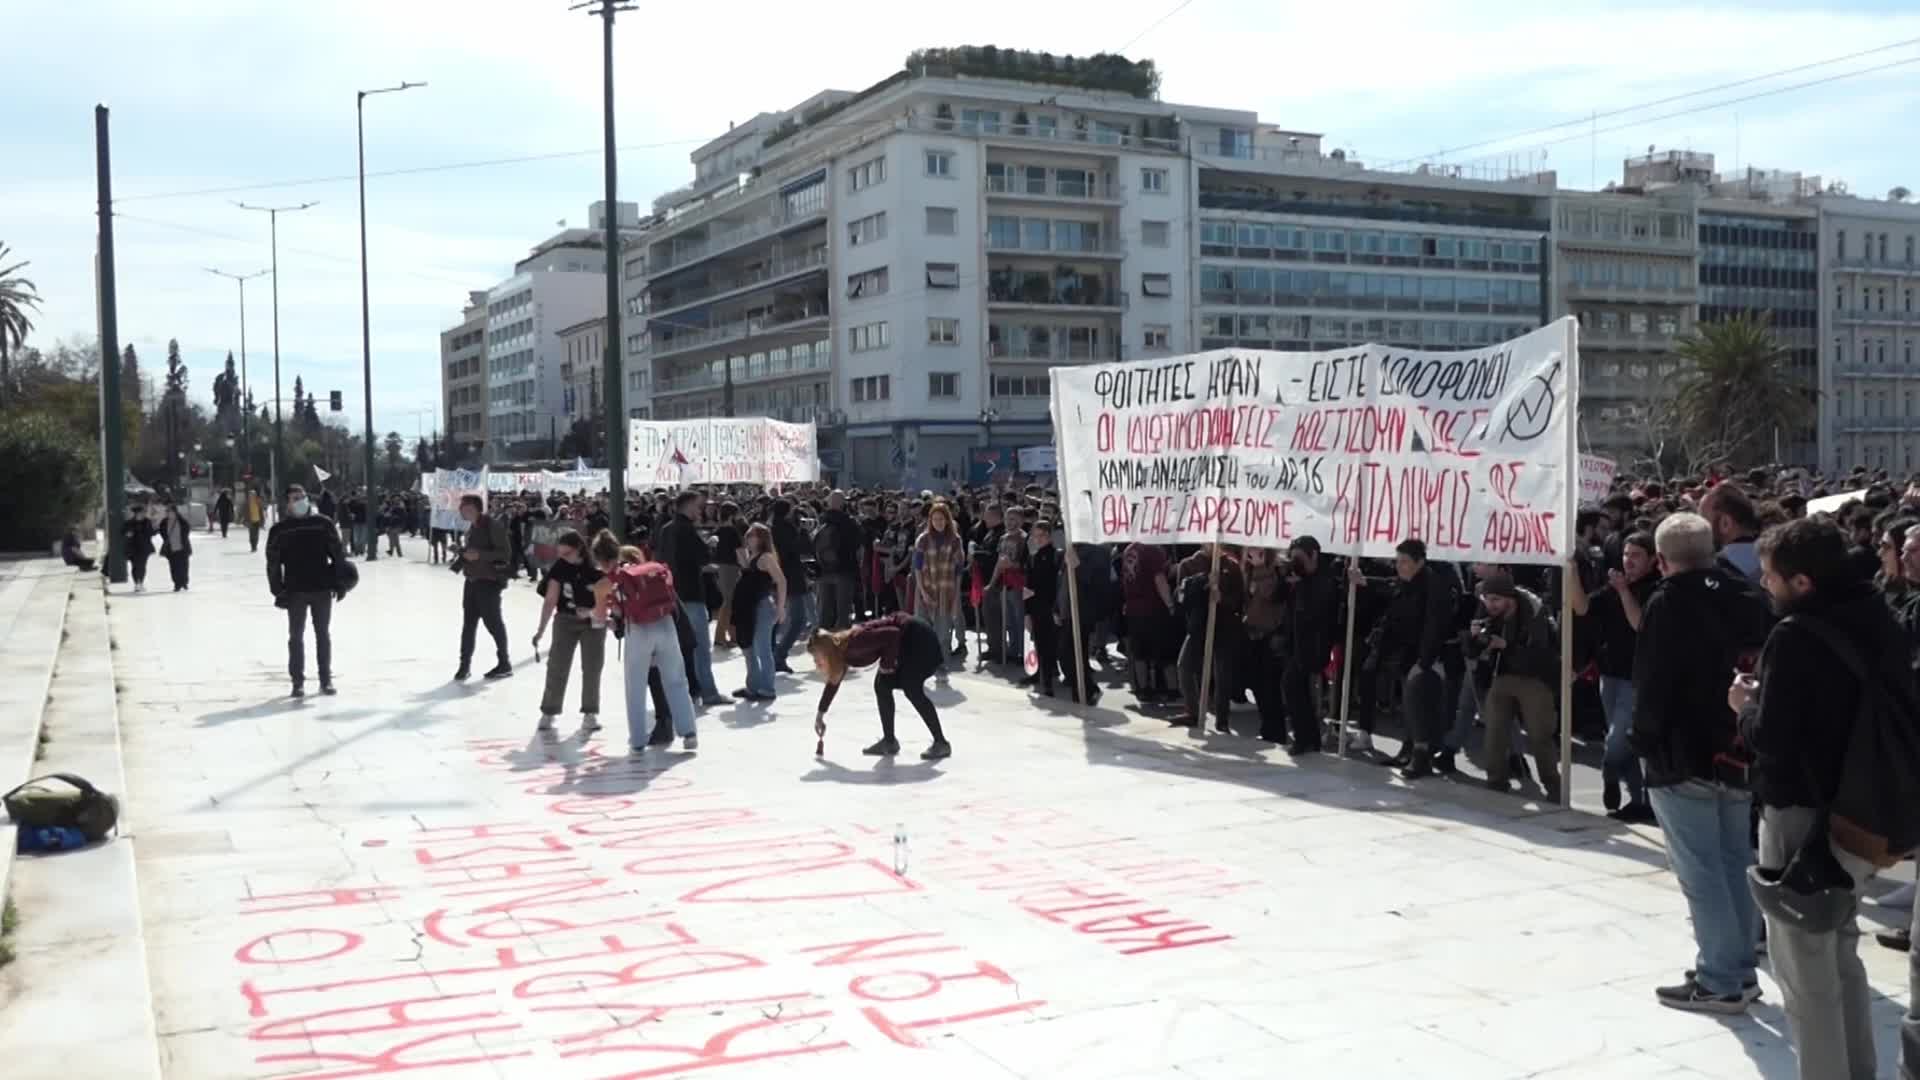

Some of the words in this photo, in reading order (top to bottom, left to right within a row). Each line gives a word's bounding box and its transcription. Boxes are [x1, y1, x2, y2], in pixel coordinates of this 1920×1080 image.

[1094, 362, 1196, 409] ΦΟΙΤΗΤΕΣ
[1207, 356, 1261, 400] ΗΤΑΝ
[1380, 350, 1512, 402] ΔΟΛΟΦΟΝΟΙ
[1097, 412, 1116, 451] ΟΙ
[1290, 405, 1406, 453] ΚΟΣΤΙΖΟΥΝ
[1102, 494, 1129, 536] ΘΑ
[1330, 462, 1471, 548] ΚΑΤΑΛΗΨΕΙΣ
[1483, 511, 1556, 555] ΑΘΗΝΑΣ
